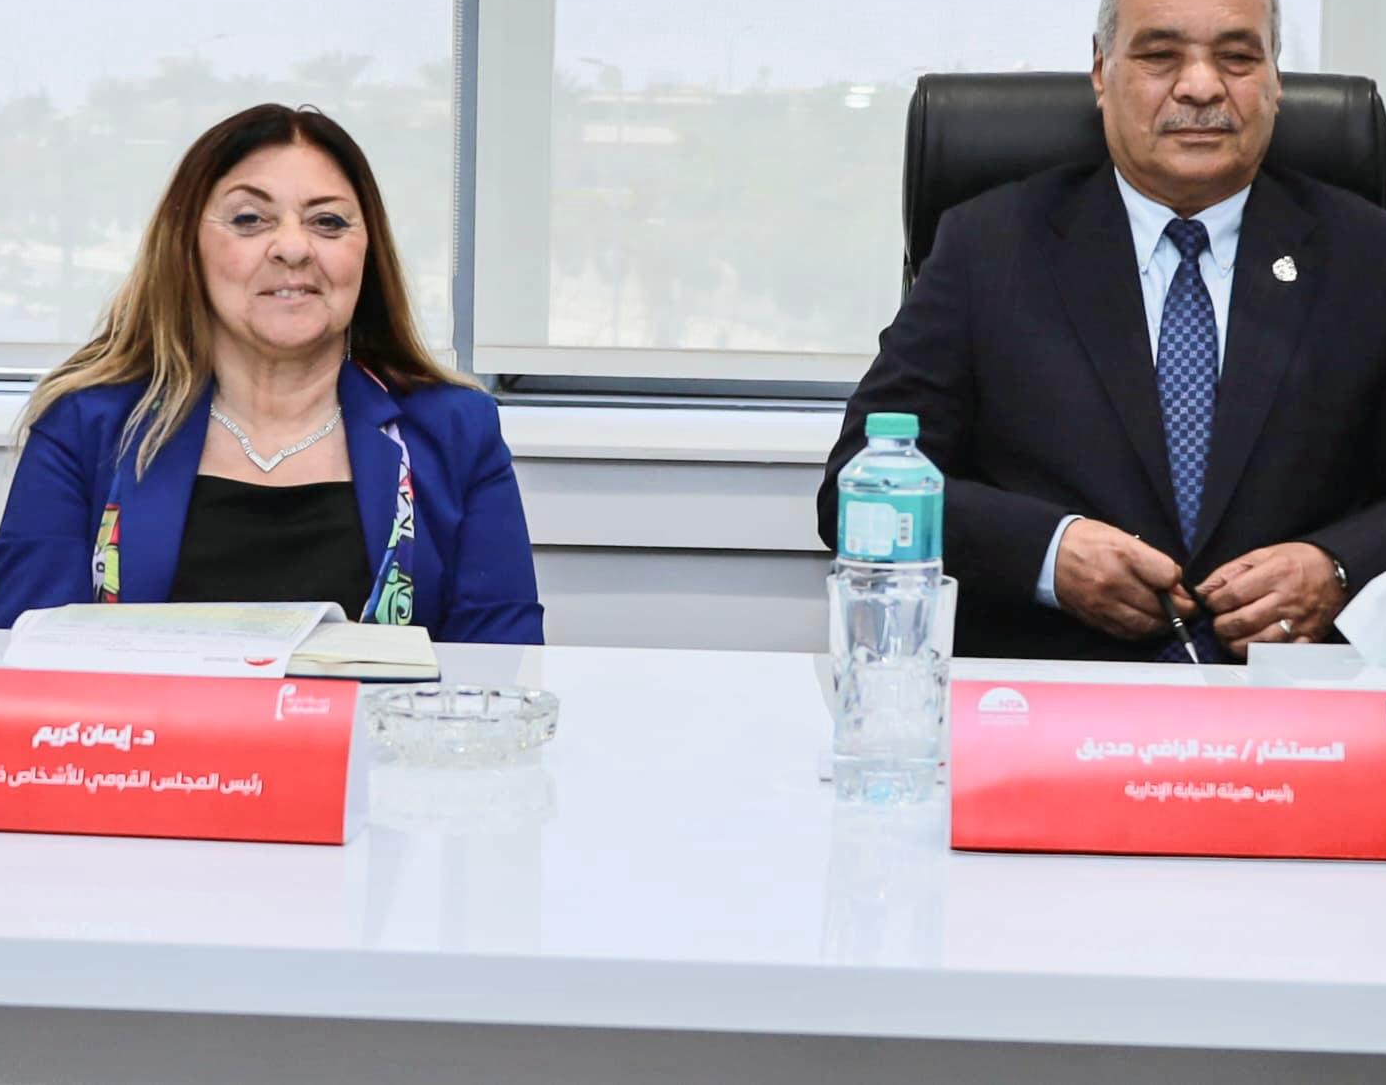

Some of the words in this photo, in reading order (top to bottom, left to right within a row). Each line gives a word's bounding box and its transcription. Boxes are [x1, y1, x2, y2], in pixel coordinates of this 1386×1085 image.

[31, 721, 82, 748] كريم
[81, 724, 133, 751] إيمان
[1076, 738, 1135, 760] صديق
[1138, 738, 1199, 764] الراضي
[1203, 741, 1238, 763] عبد
[1257, 738, 1346, 763] المستشار
[8, 762, 85, 787] للأشخاص
[85, 769, 150, 794] القومي
[151, 772, 219, 795] المجلس
[220, 773, 264, 796] رئيس
[1173, 782, 1217, 801] النيابة
[1217, 782, 1255, 800] هيئة
[1255, 783, 1295, 803] رئيس
